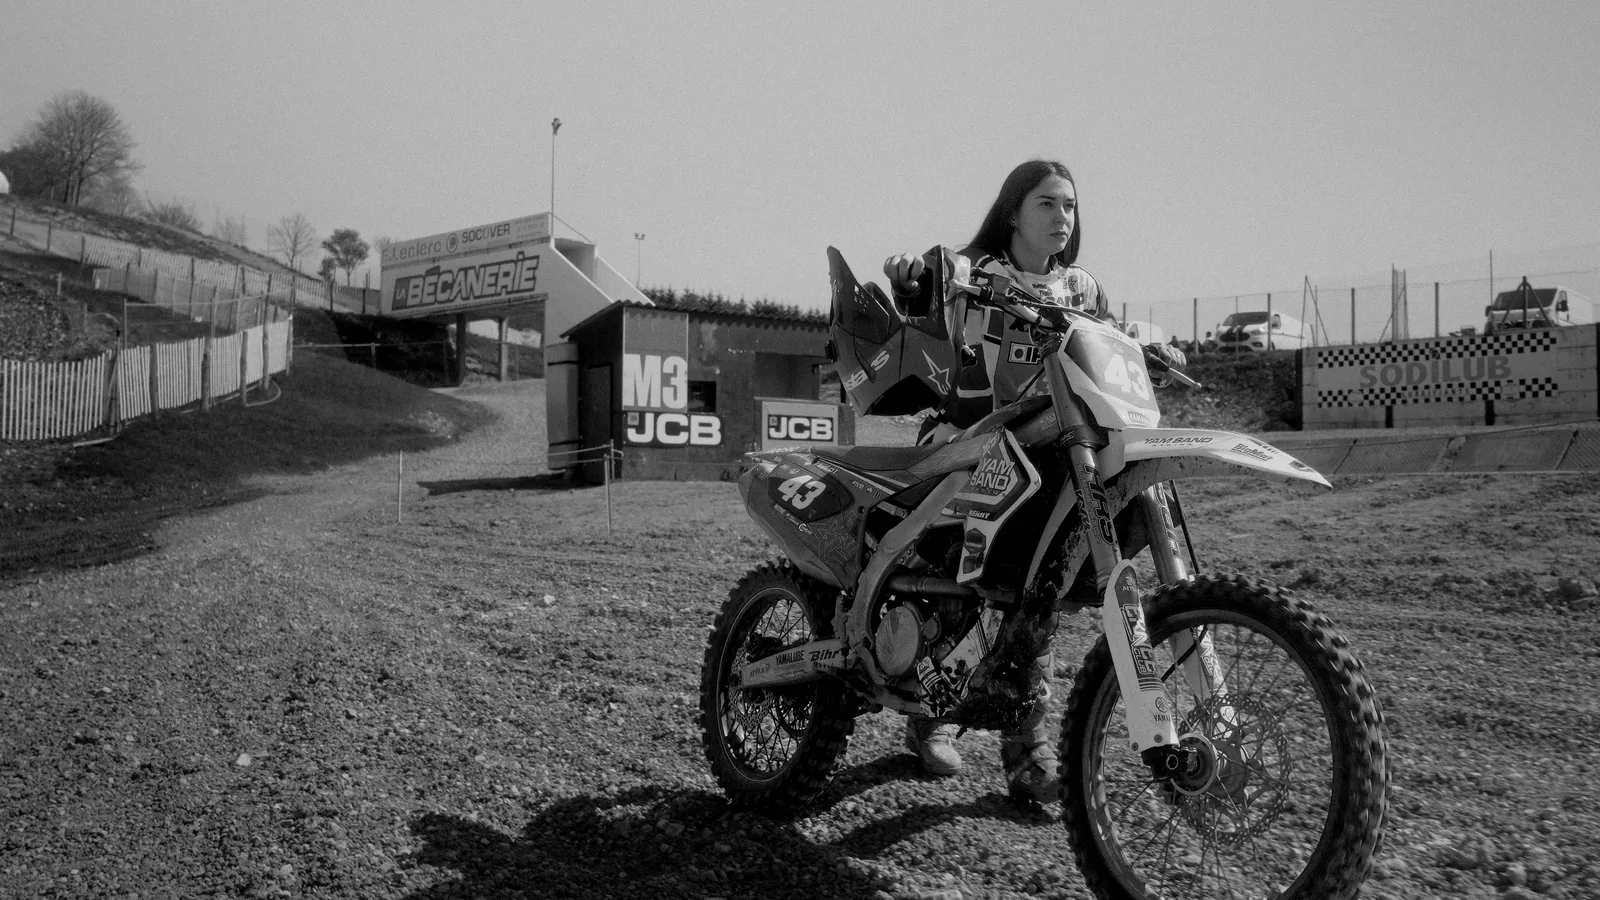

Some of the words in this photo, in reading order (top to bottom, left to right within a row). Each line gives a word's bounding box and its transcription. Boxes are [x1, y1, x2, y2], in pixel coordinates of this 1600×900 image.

[462, 223, 510, 244] SOCOVER
[622, 353, 688, 409] M3
[1104, 353, 1150, 401] 43
[627, 412, 722, 445] JCB
[768, 416, 833, 440] JCB
[981, 458, 1016, 474] YAM
[970, 472, 1010, 490] SAND
[778, 475, 827, 510] 43
[969, 510, 990, 519] KENNY
[808, 649, 842, 662] Bihr
